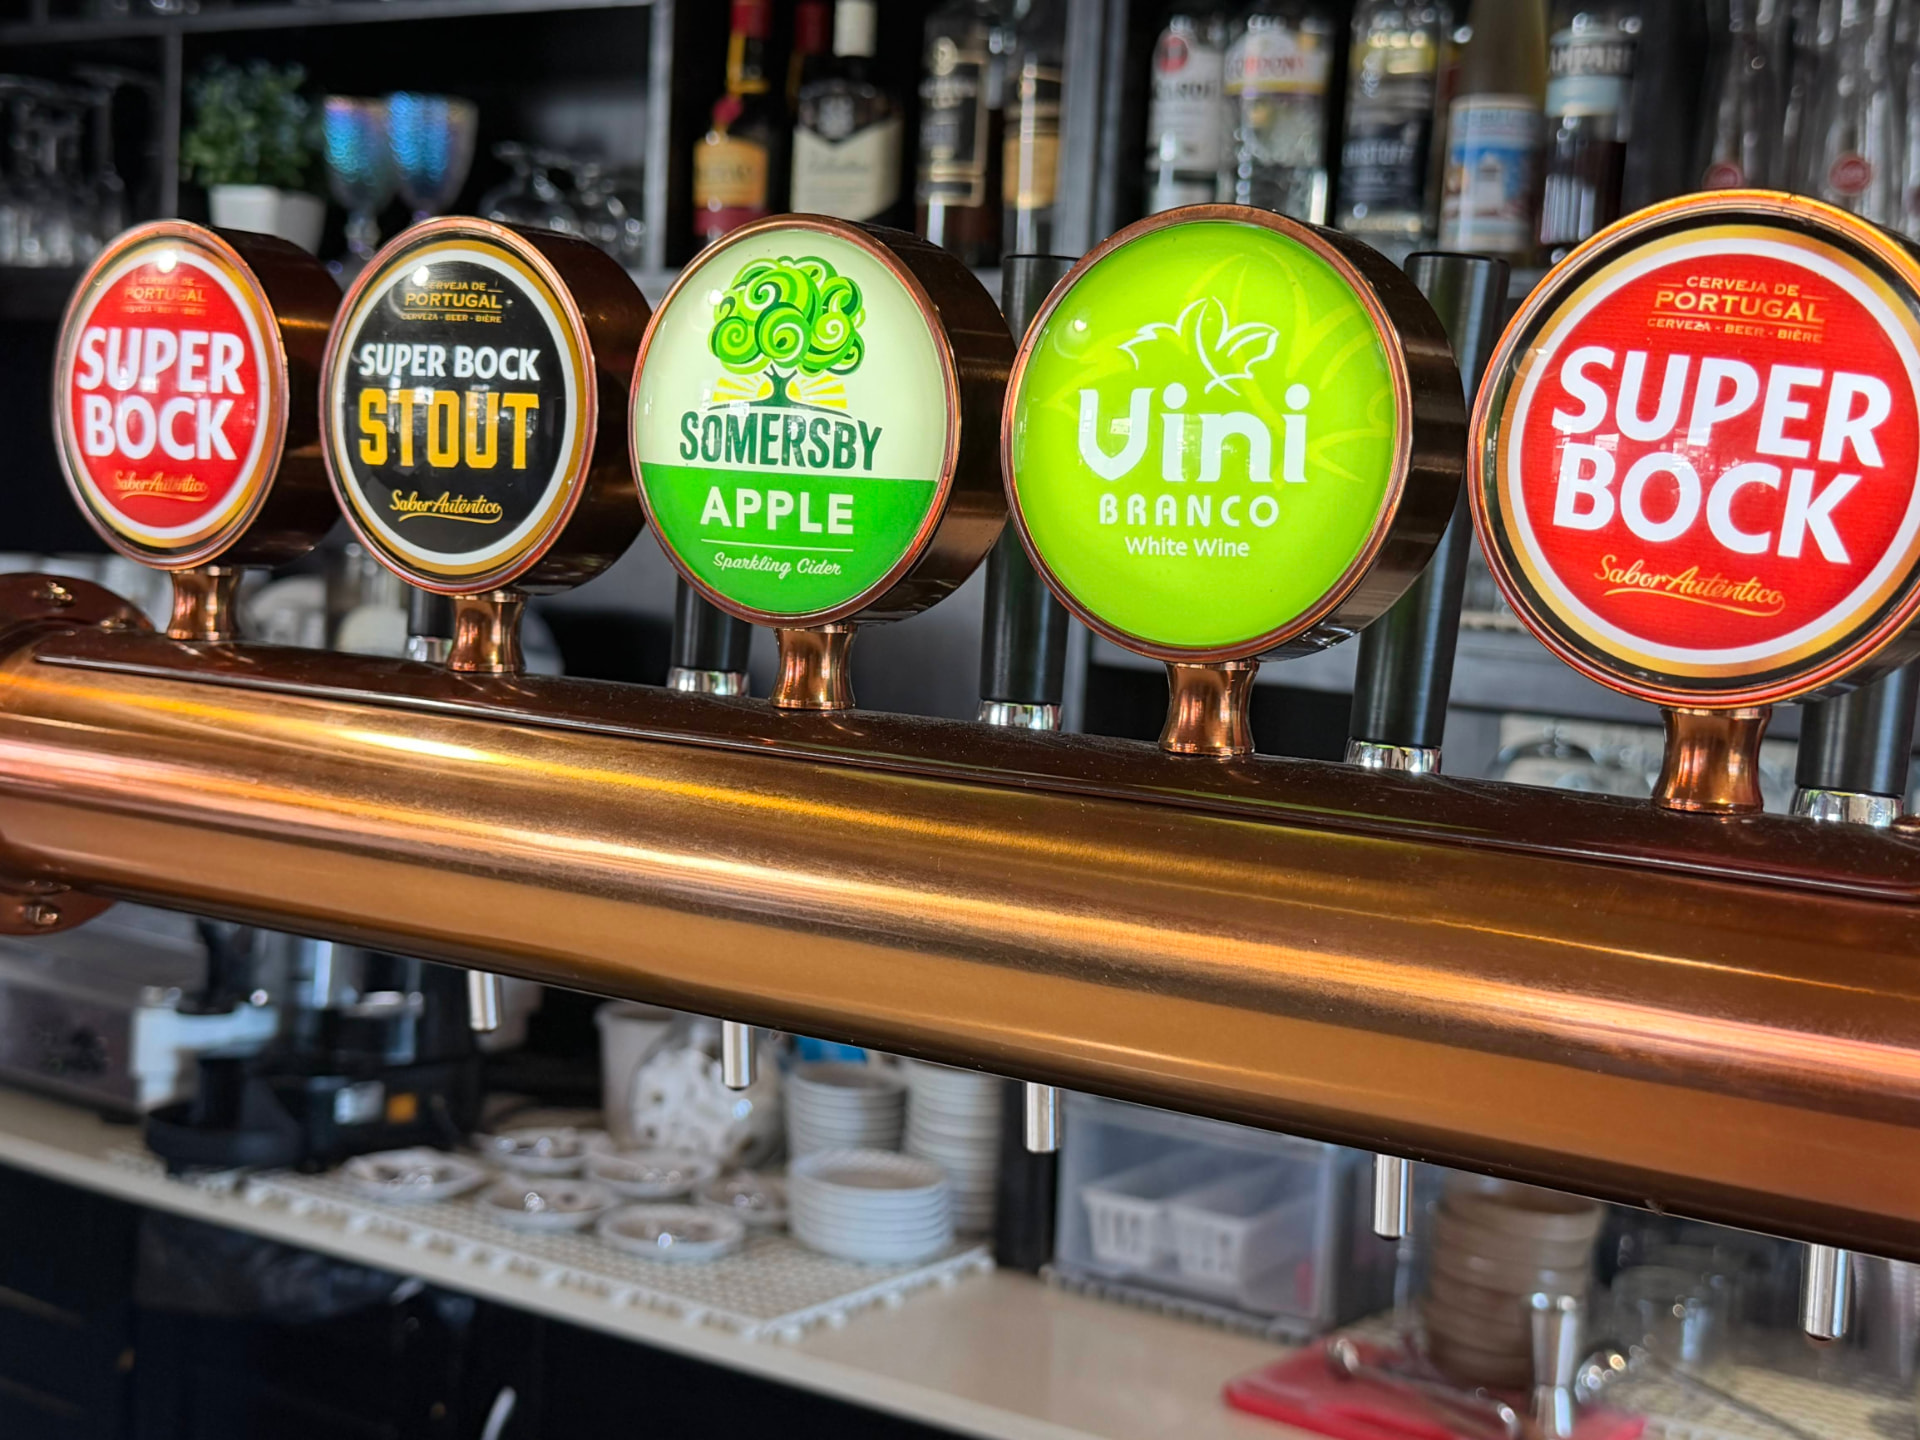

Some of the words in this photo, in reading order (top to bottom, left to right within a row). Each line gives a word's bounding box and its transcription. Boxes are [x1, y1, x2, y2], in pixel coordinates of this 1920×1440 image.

[124, 286, 207, 303] PORTUGAL
[404, 292, 503, 309] PORTUGAL
[471, 282, 487, 291] DE
[1686, 275, 1768, 294] CERVEJA
[1774, 283, 1800, 297] DE
[445, 314, 469, 322] BEER
[1654, 290, 1825, 323] PORTUGAL
[1647, 317, 1711, 333] CERVEZA
[1724, 323, 1765, 337] BEER
[1777, 328, 1824, 343] BIÈRE
[76, 326, 246, 394] SUPER
[359, 343, 447, 378] SUPER
[454, 345, 541, 381] BOCK
[1551, 345, 1893, 468] SUPER
[83, 394, 238, 460] BOCK
[358, 388, 540, 470] STOUT
[679, 410, 883, 471] SOMERSBY
[114, 470, 148, 492] Sabor
[389, 489, 432, 512] Sabor
[700, 486, 854, 535] APPLE
[1099, 493, 1279, 528] BRANCO
[1552, 442, 1863, 564] BOCK
[1124, 536, 1188, 556] White
[1193, 538, 1250, 557] Wine
[712, 552, 791, 579] Sparkling
[797, 557, 842, 576] Cider
[1594, 554, 1668, 590] Sabor
